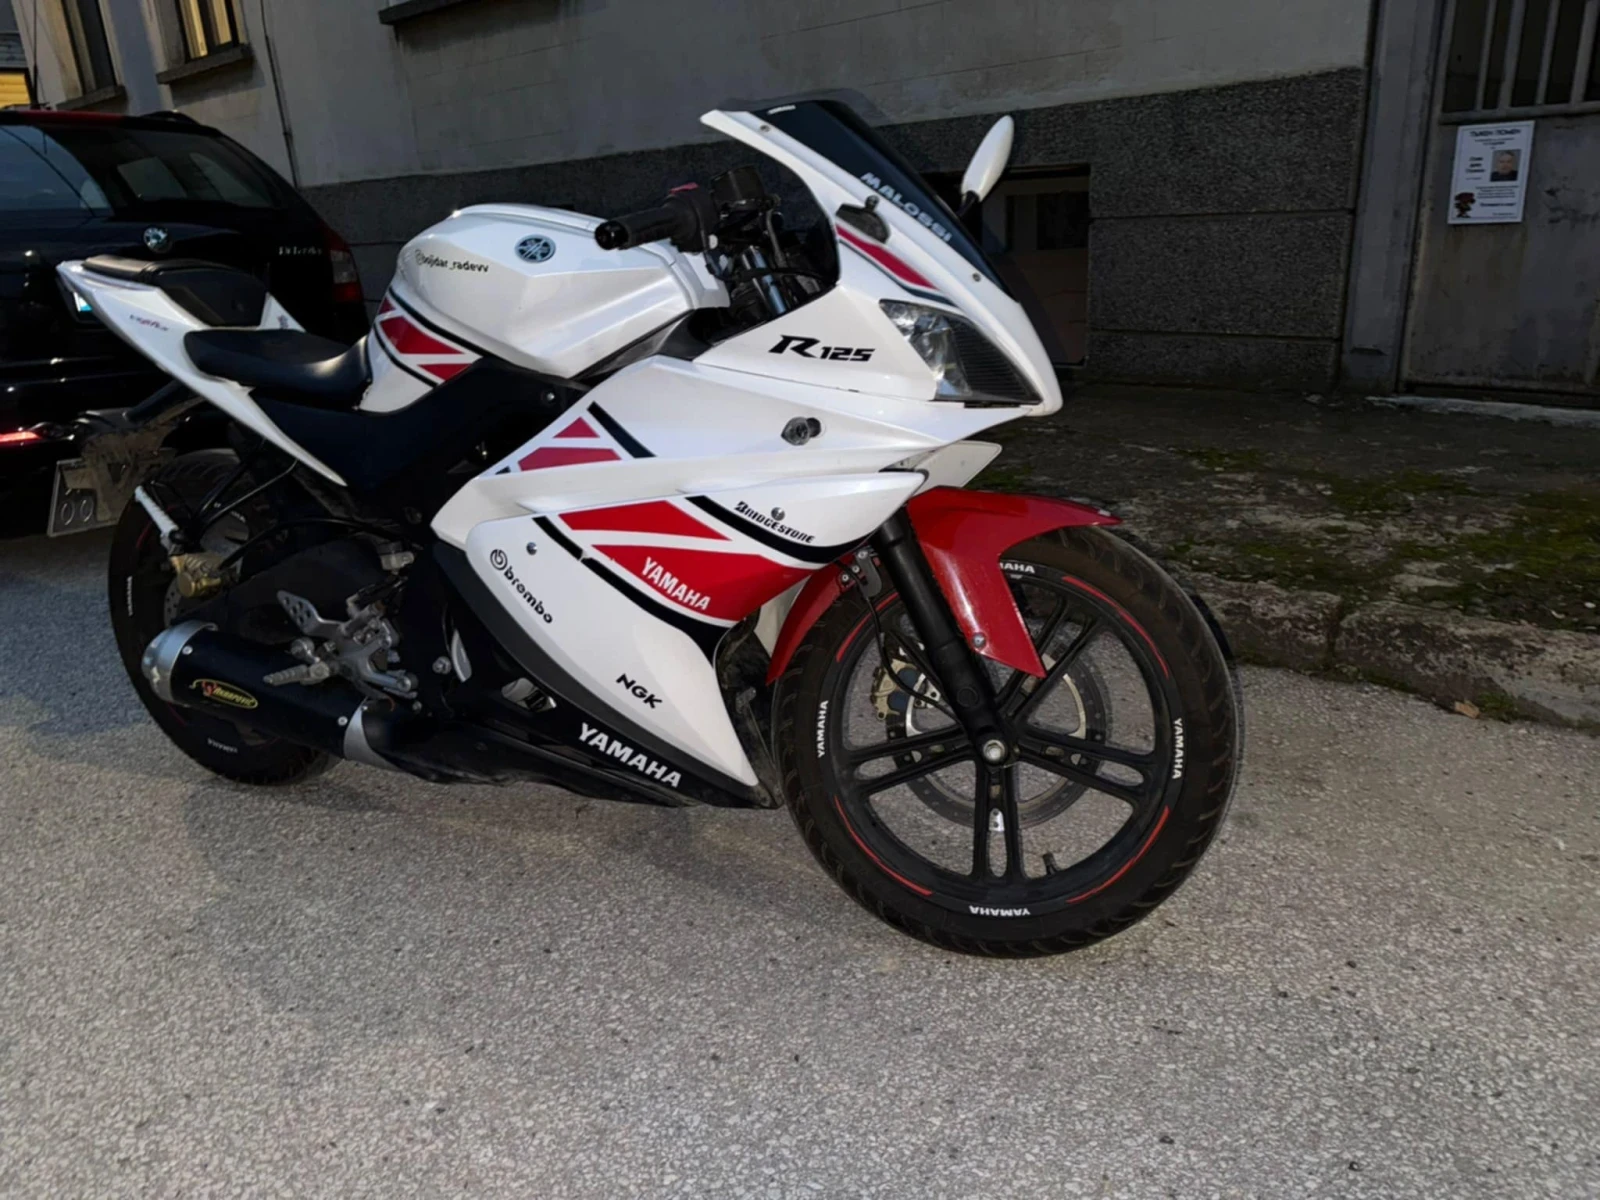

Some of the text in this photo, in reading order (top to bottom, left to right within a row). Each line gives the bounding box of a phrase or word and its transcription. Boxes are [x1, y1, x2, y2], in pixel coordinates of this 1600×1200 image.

[861, 172, 952, 242] MALOSSI
[734, 501, 815, 544] BRIDGESTONE
[504, 565, 553, 624] brembo
[642, 556, 711, 610] YAMAHA
[999, 562, 1036, 574] AHA
[616, 673, 662, 709] NGK
[578, 722, 682, 788] YAMAHA
[817, 700, 829, 758] YAMAHA
[1172, 717, 1184, 779] YAMAHA
[968, 904, 1031, 917] YAMAHA
